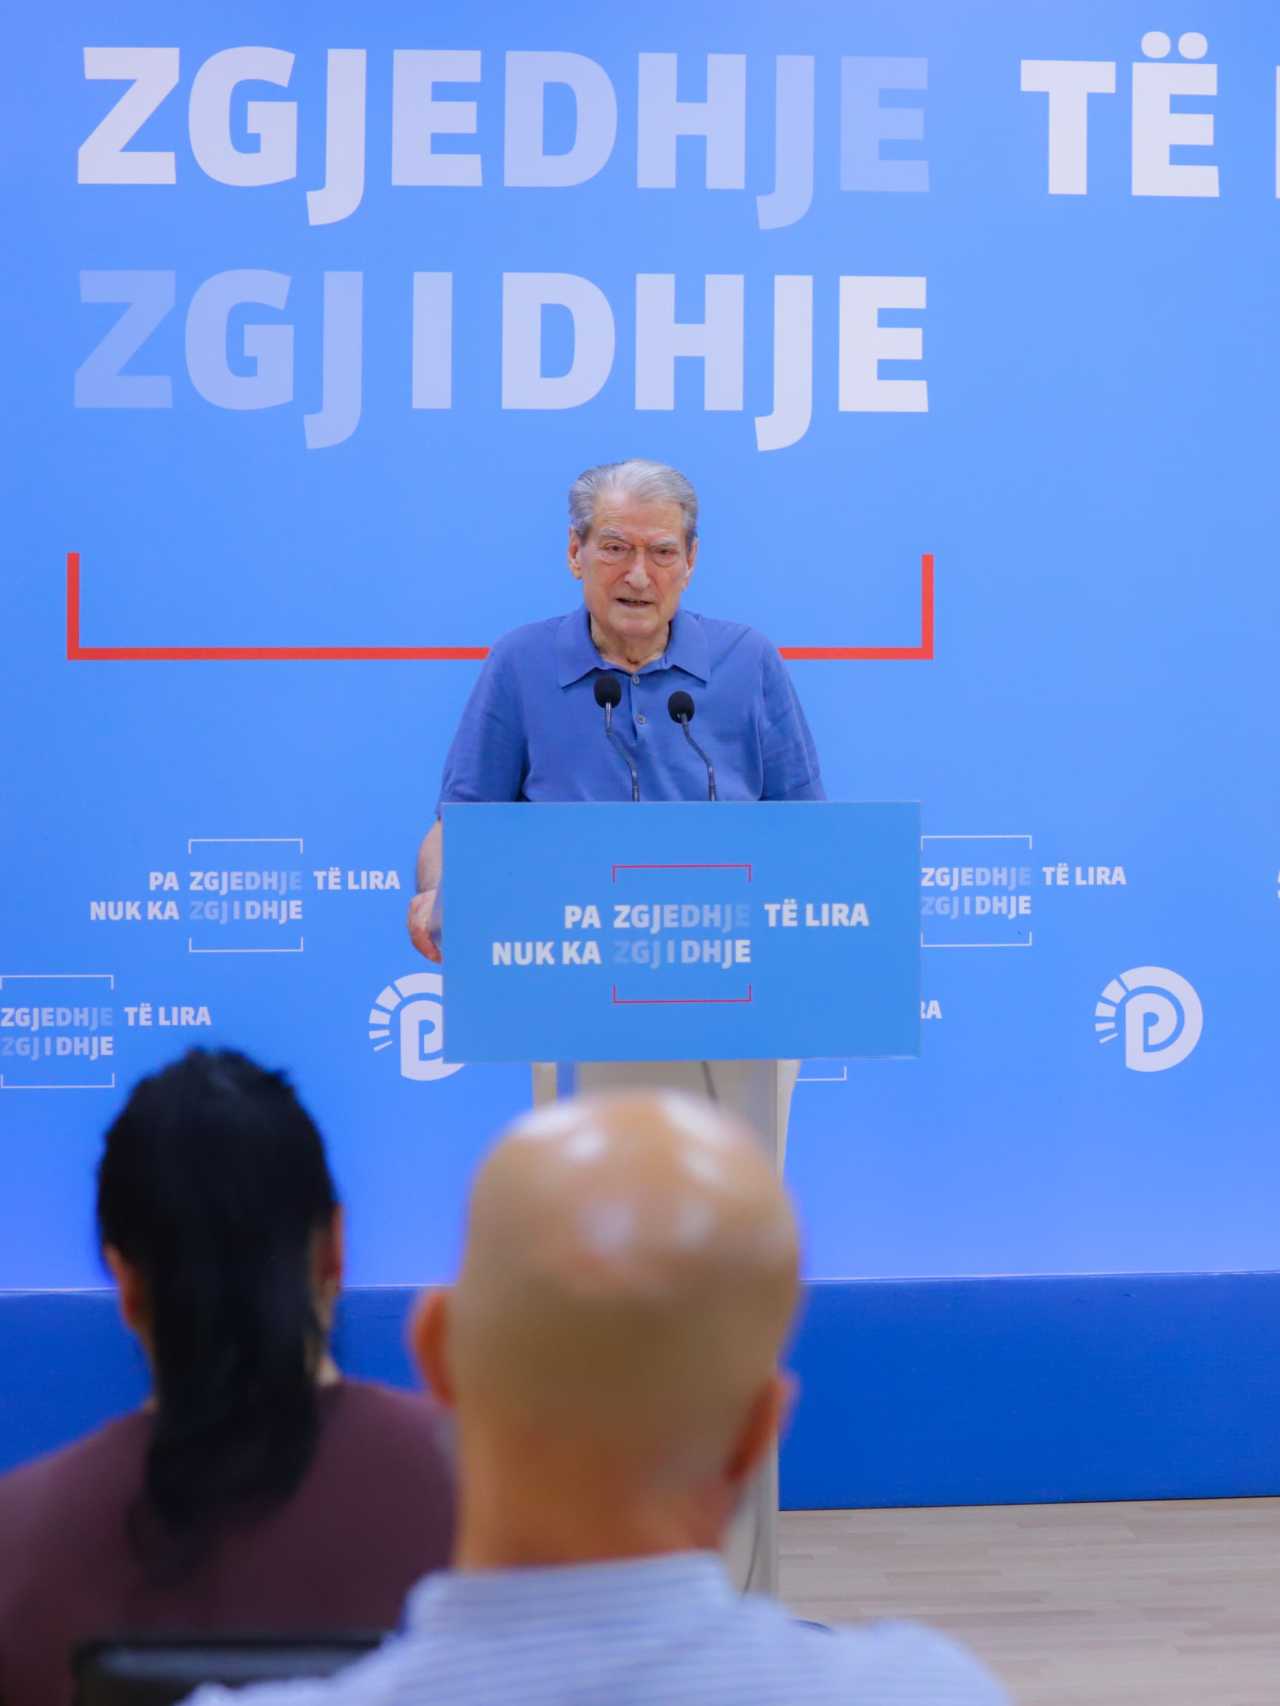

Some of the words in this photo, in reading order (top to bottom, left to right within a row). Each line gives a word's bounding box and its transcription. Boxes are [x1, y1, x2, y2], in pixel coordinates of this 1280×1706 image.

[77, 45, 931, 230] ZGJEDHJE
[1020, 31, 1220, 198] TË
[148, 871, 180, 891] PA
[188, 871, 302, 896] ZGJEDHJE
[312, 866, 342, 891] TË
[347, 870, 401, 891] LIRA
[921, 867, 1031, 892] ZGJEDHJE
[1041, 862, 1070, 886] TË
[1075, 866, 1128, 886] LIRA
[89, 901, 142, 922] NUK
[146, 900, 180, 920] KA
[564, 904, 602, 930] PA
[612, 903, 750, 934] ZGJEDHJE
[763, 898, 800, 928] TË
[804, 902, 870, 928] LIRA
[492, 940, 557, 966] NUK
[561, 940, 603, 966] KA
[0, 1007, 113, 1032] ZGJEDHJE
[123, 1002, 153, 1027] TË
[158, 1006, 212, 1026] LIRA
